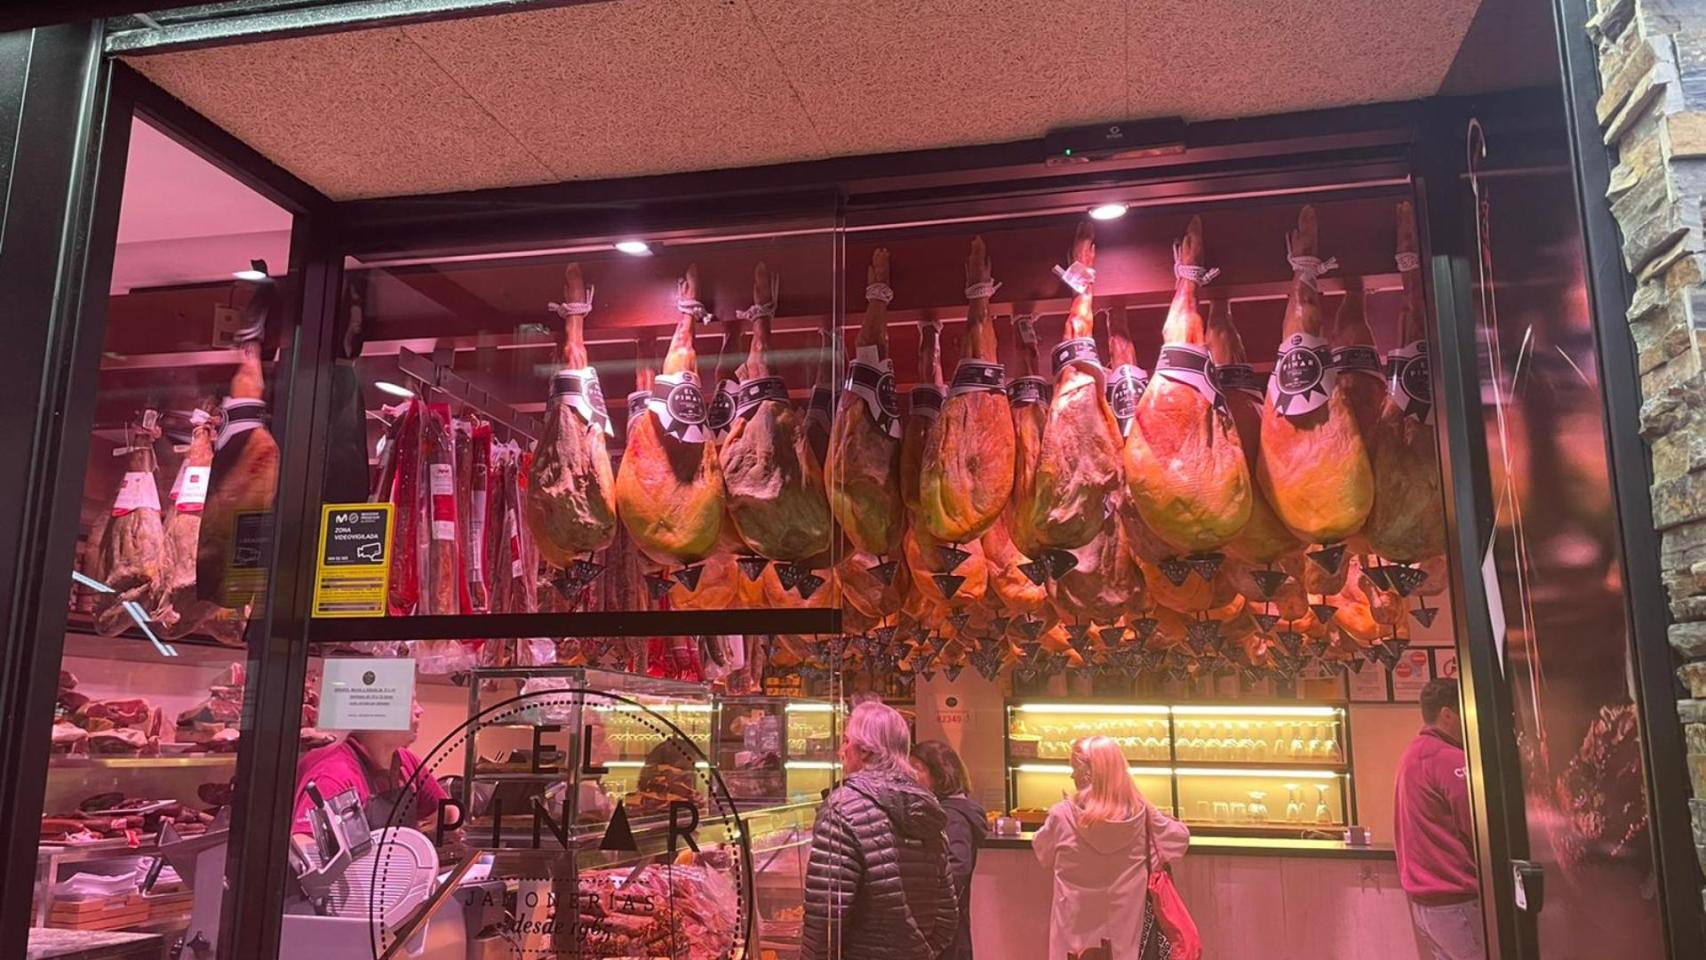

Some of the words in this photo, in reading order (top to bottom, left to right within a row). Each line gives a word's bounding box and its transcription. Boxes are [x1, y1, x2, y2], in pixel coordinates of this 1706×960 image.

[335, 533, 378, 541] VIDEOVIGILADA
[532, 724, 609, 774] EL
[434, 798, 700, 852] PINAR
[464, 891, 655, 911] JAMONERIAS
[511, 913, 567, 938] desde
